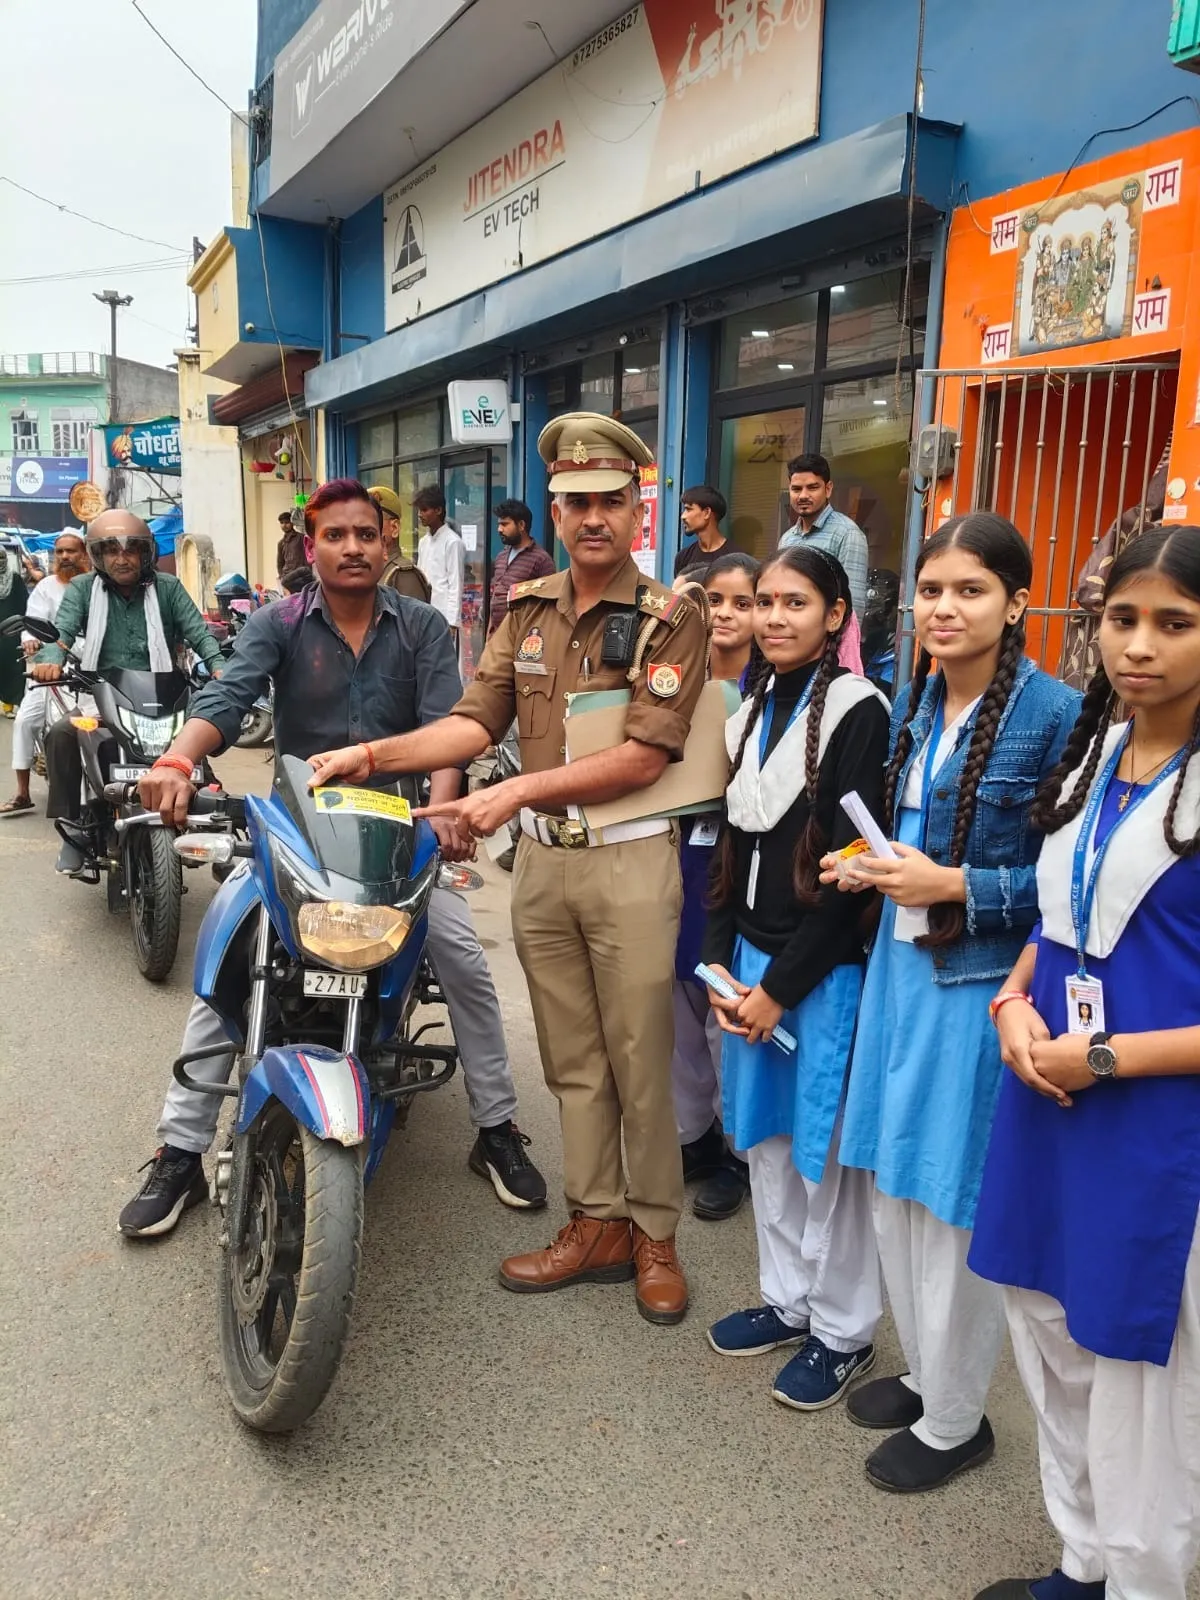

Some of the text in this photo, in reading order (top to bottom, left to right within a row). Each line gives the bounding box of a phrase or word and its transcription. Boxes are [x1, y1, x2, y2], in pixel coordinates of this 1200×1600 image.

[463, 119, 566, 212] JITENDRA
[1146, 167, 1179, 205] राम
[483, 187, 540, 239] EV TECH
[992, 215, 1018, 249] राम
[1134, 295, 1168, 330] राम
[983, 328, 1010, 359] राम
